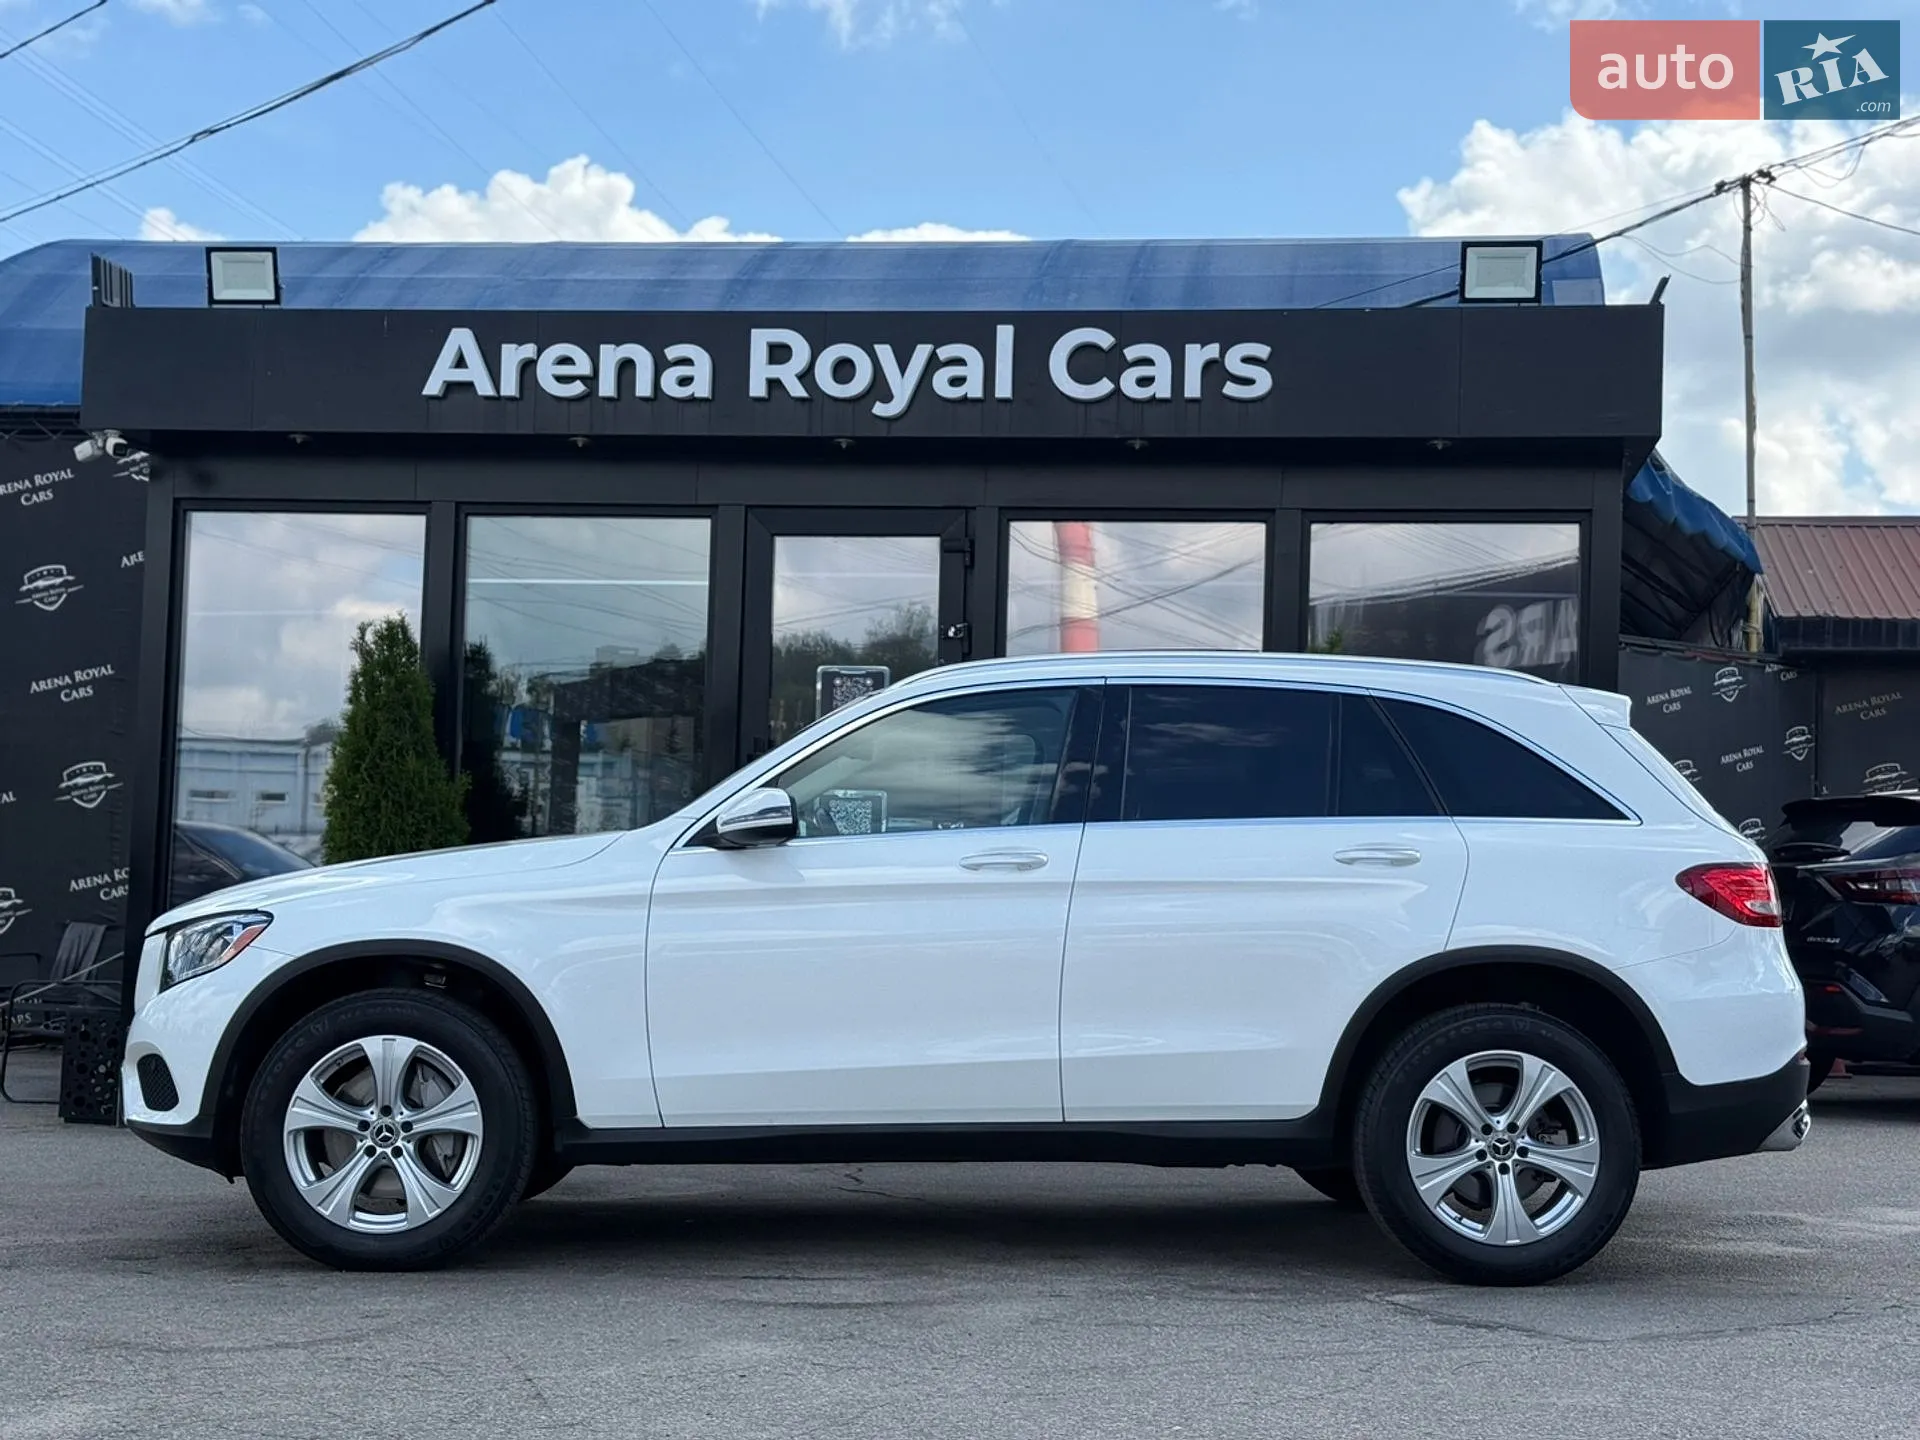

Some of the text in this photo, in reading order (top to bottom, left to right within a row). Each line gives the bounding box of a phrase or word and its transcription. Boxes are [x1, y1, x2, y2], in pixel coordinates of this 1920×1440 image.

[421, 324, 1274, 417] Arena Royal Cars
[34, 468, 75, 486] ROYAL
[21, 488, 54, 506] CARS
[30, 664, 116, 694] ARENA ROYAL
[60, 685, 94, 702] CARS
[70, 873, 112, 892] ARENA
